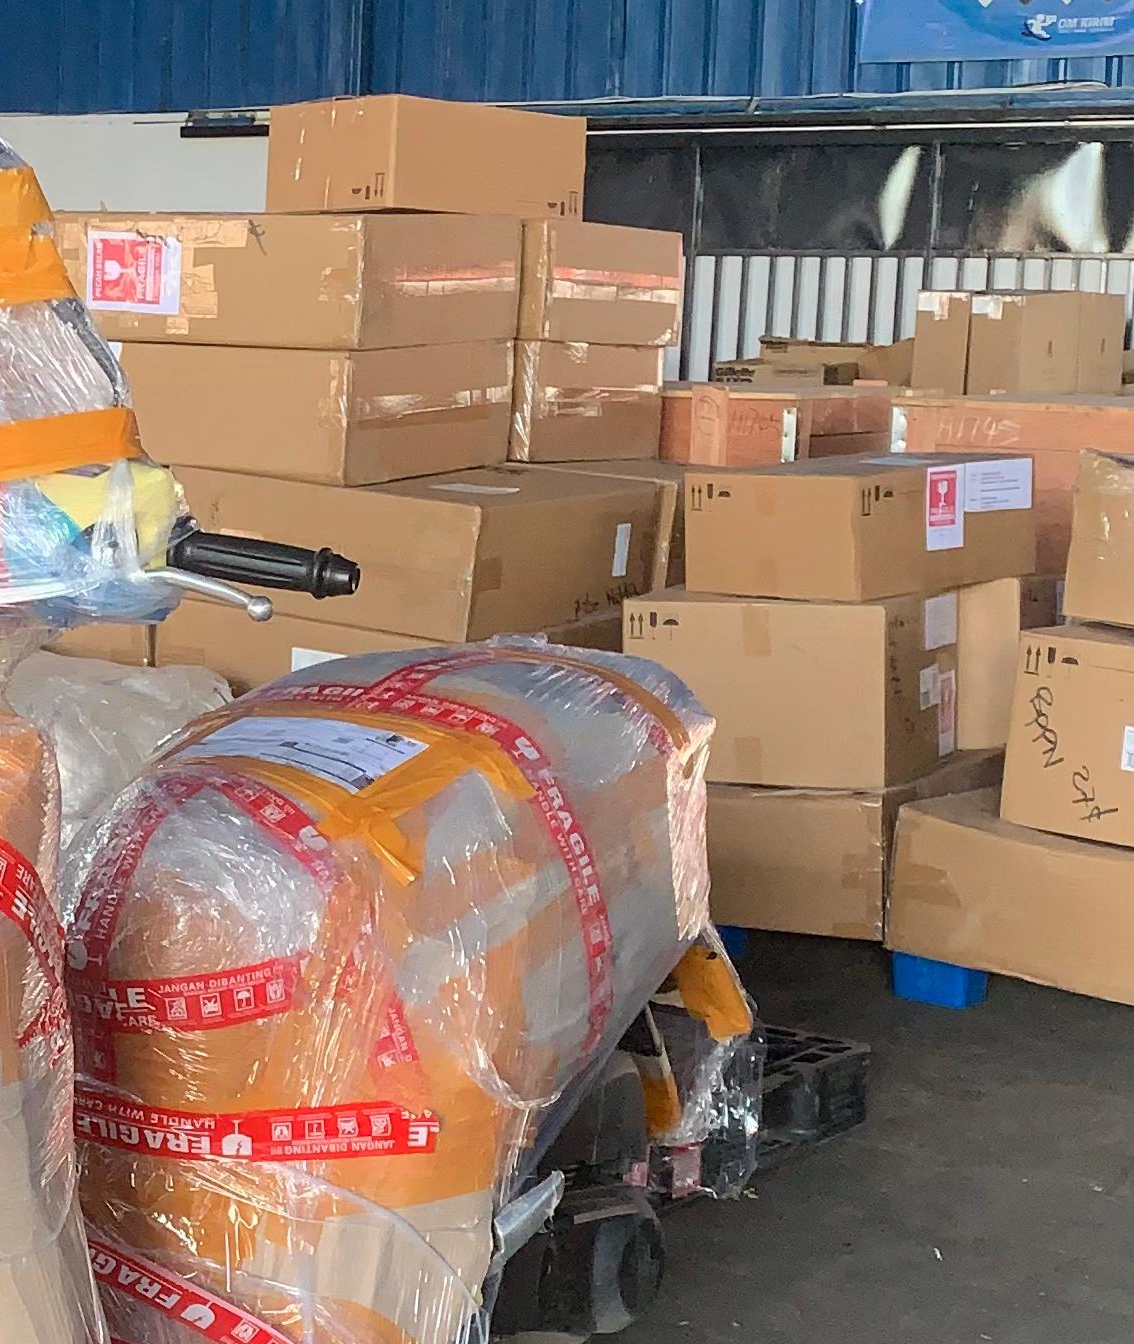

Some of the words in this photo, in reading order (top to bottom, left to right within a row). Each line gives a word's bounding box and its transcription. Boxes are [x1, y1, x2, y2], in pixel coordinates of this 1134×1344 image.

[158, 981, 205, 994] JANGAN
[209, 967, 272, 986] DIBANTING
[108, 1104, 145, 1121] WITH
[150, 1112, 216, 1129] HANDLE
[284, 1142, 348, 1155] DIBANTING
[351, 1139, 396, 1152] JANGAN
